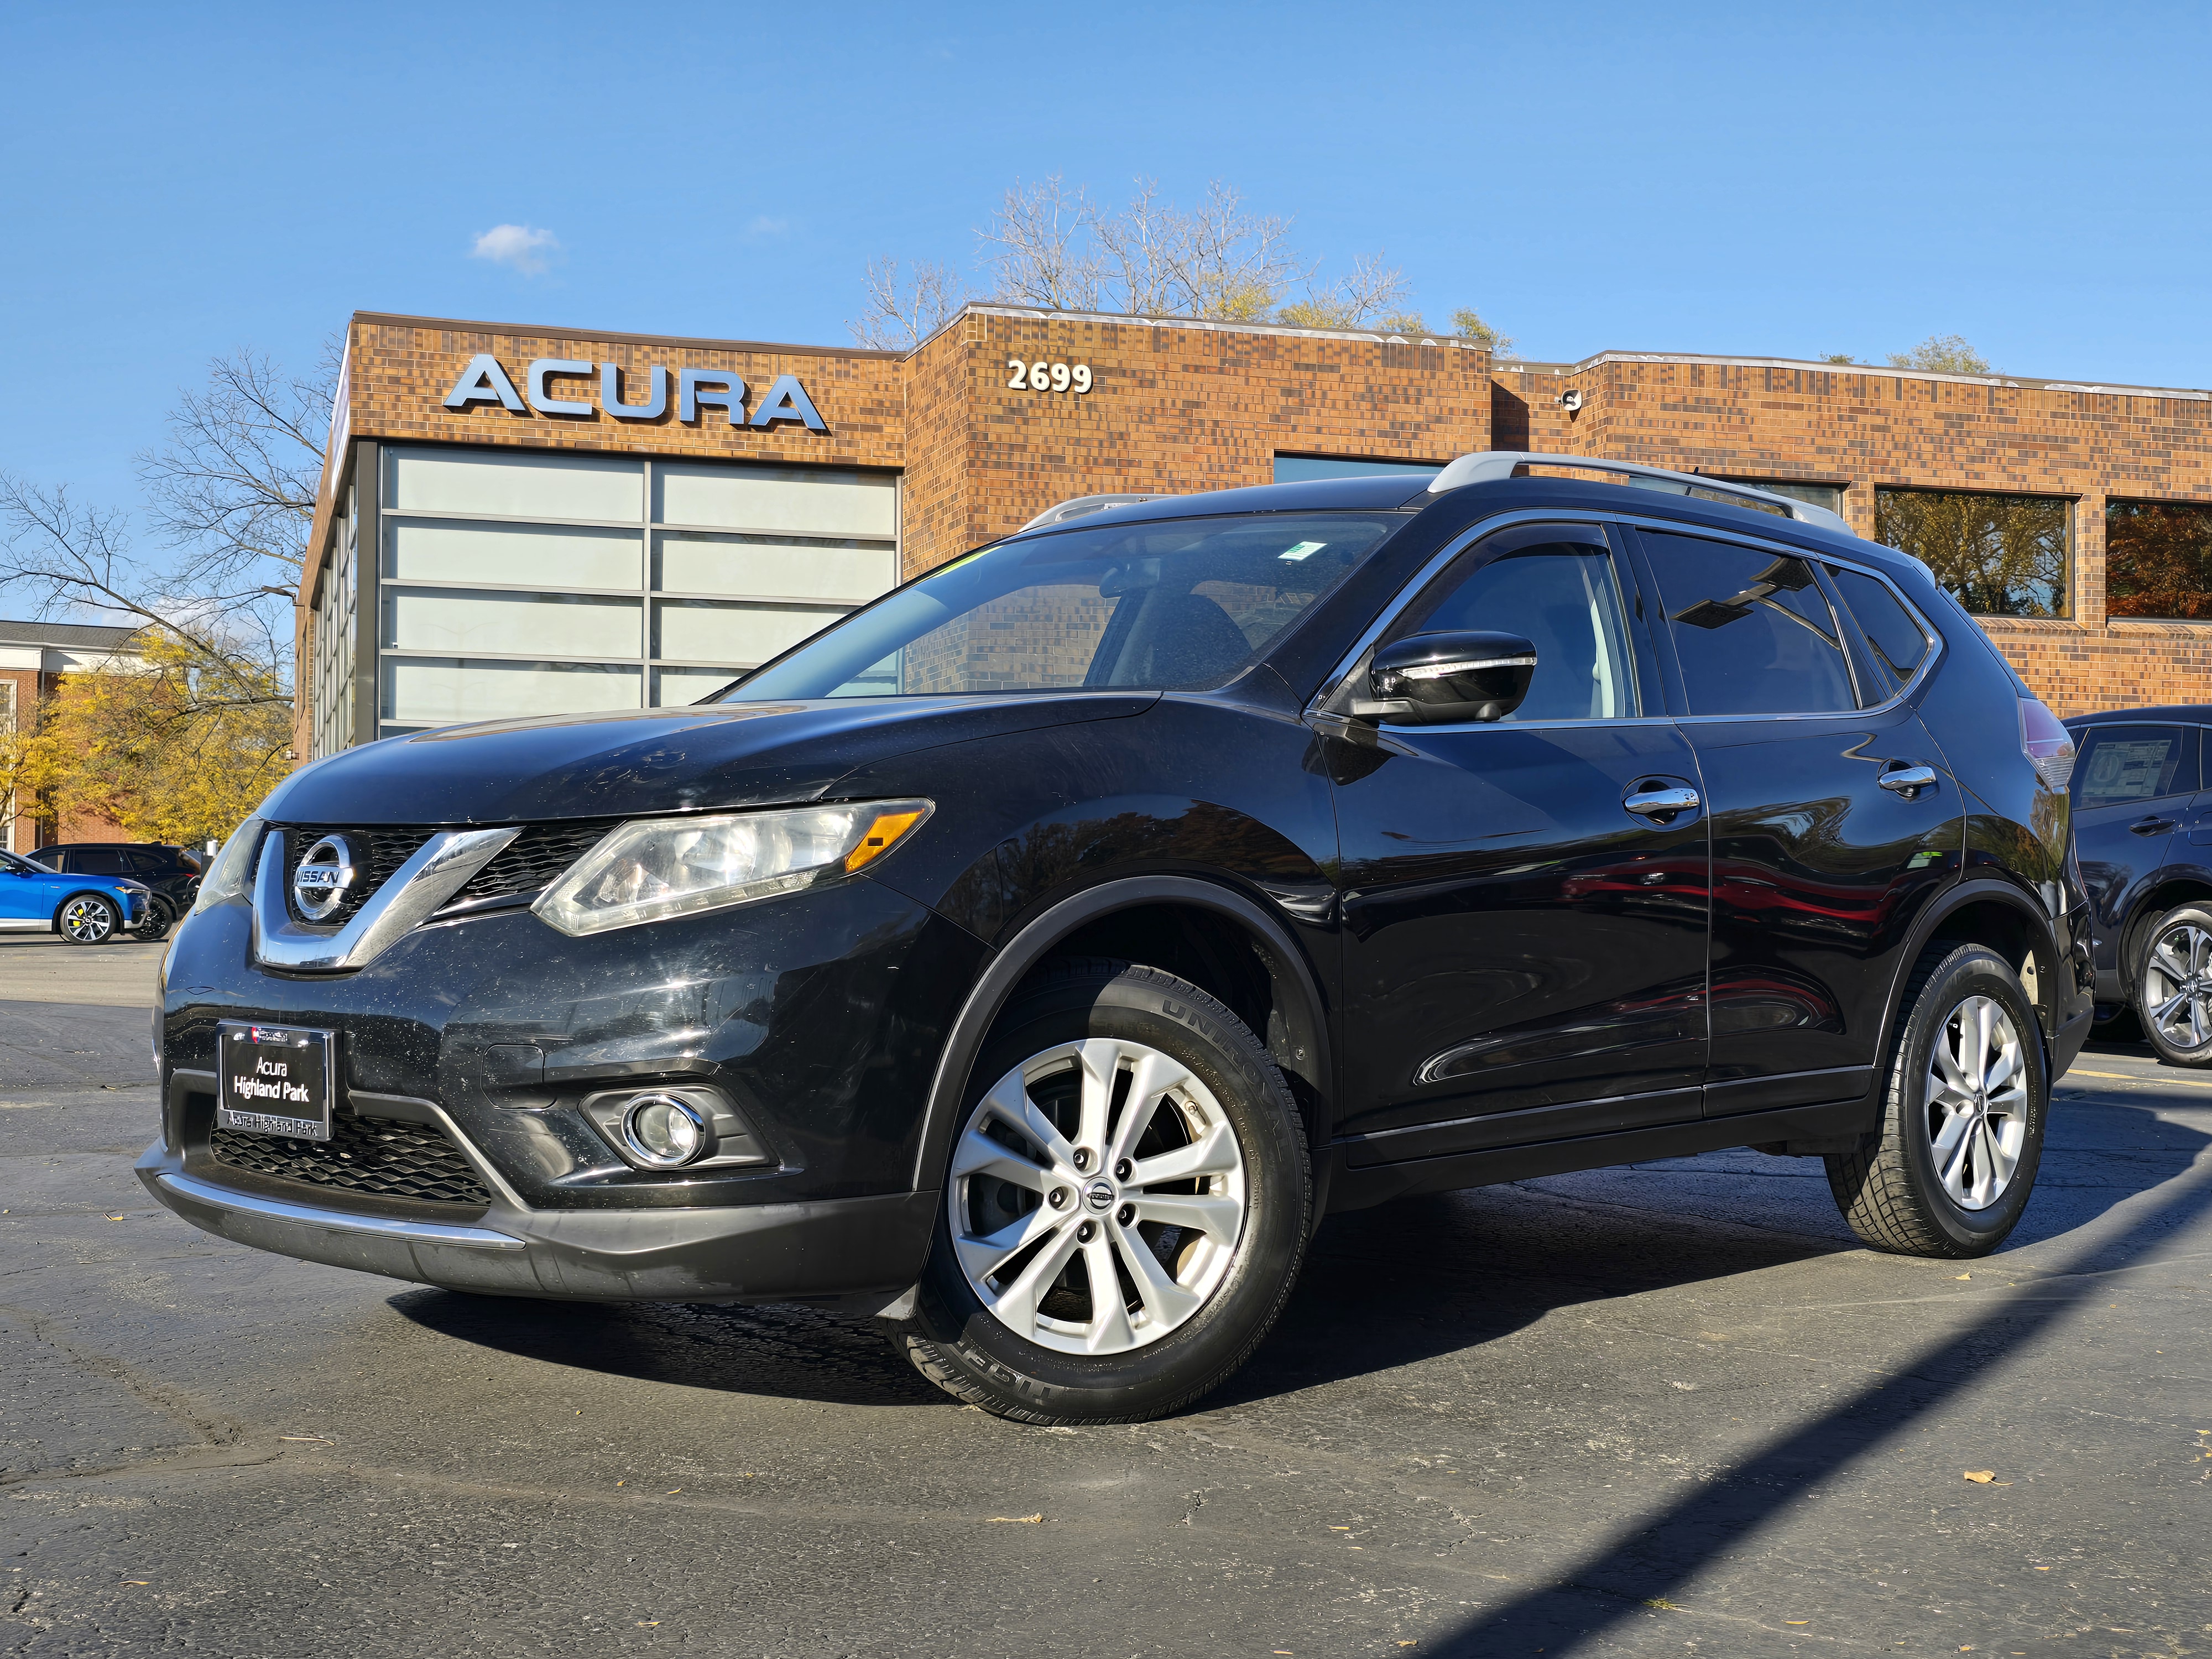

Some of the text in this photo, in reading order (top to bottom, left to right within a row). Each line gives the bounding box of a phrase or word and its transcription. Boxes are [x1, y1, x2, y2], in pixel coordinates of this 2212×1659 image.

[1008, 359, 1093, 394] 2699
[443, 353, 827, 431] ACURA
[297, 870, 340, 884] NISSAN
[255, 1056, 288, 1077] Acura
[1161, 999, 1288, 1162] UNIROYAL
[233, 1075, 310, 1103] Highland Park
[227, 1110, 318, 1136] Acura Highland Park
